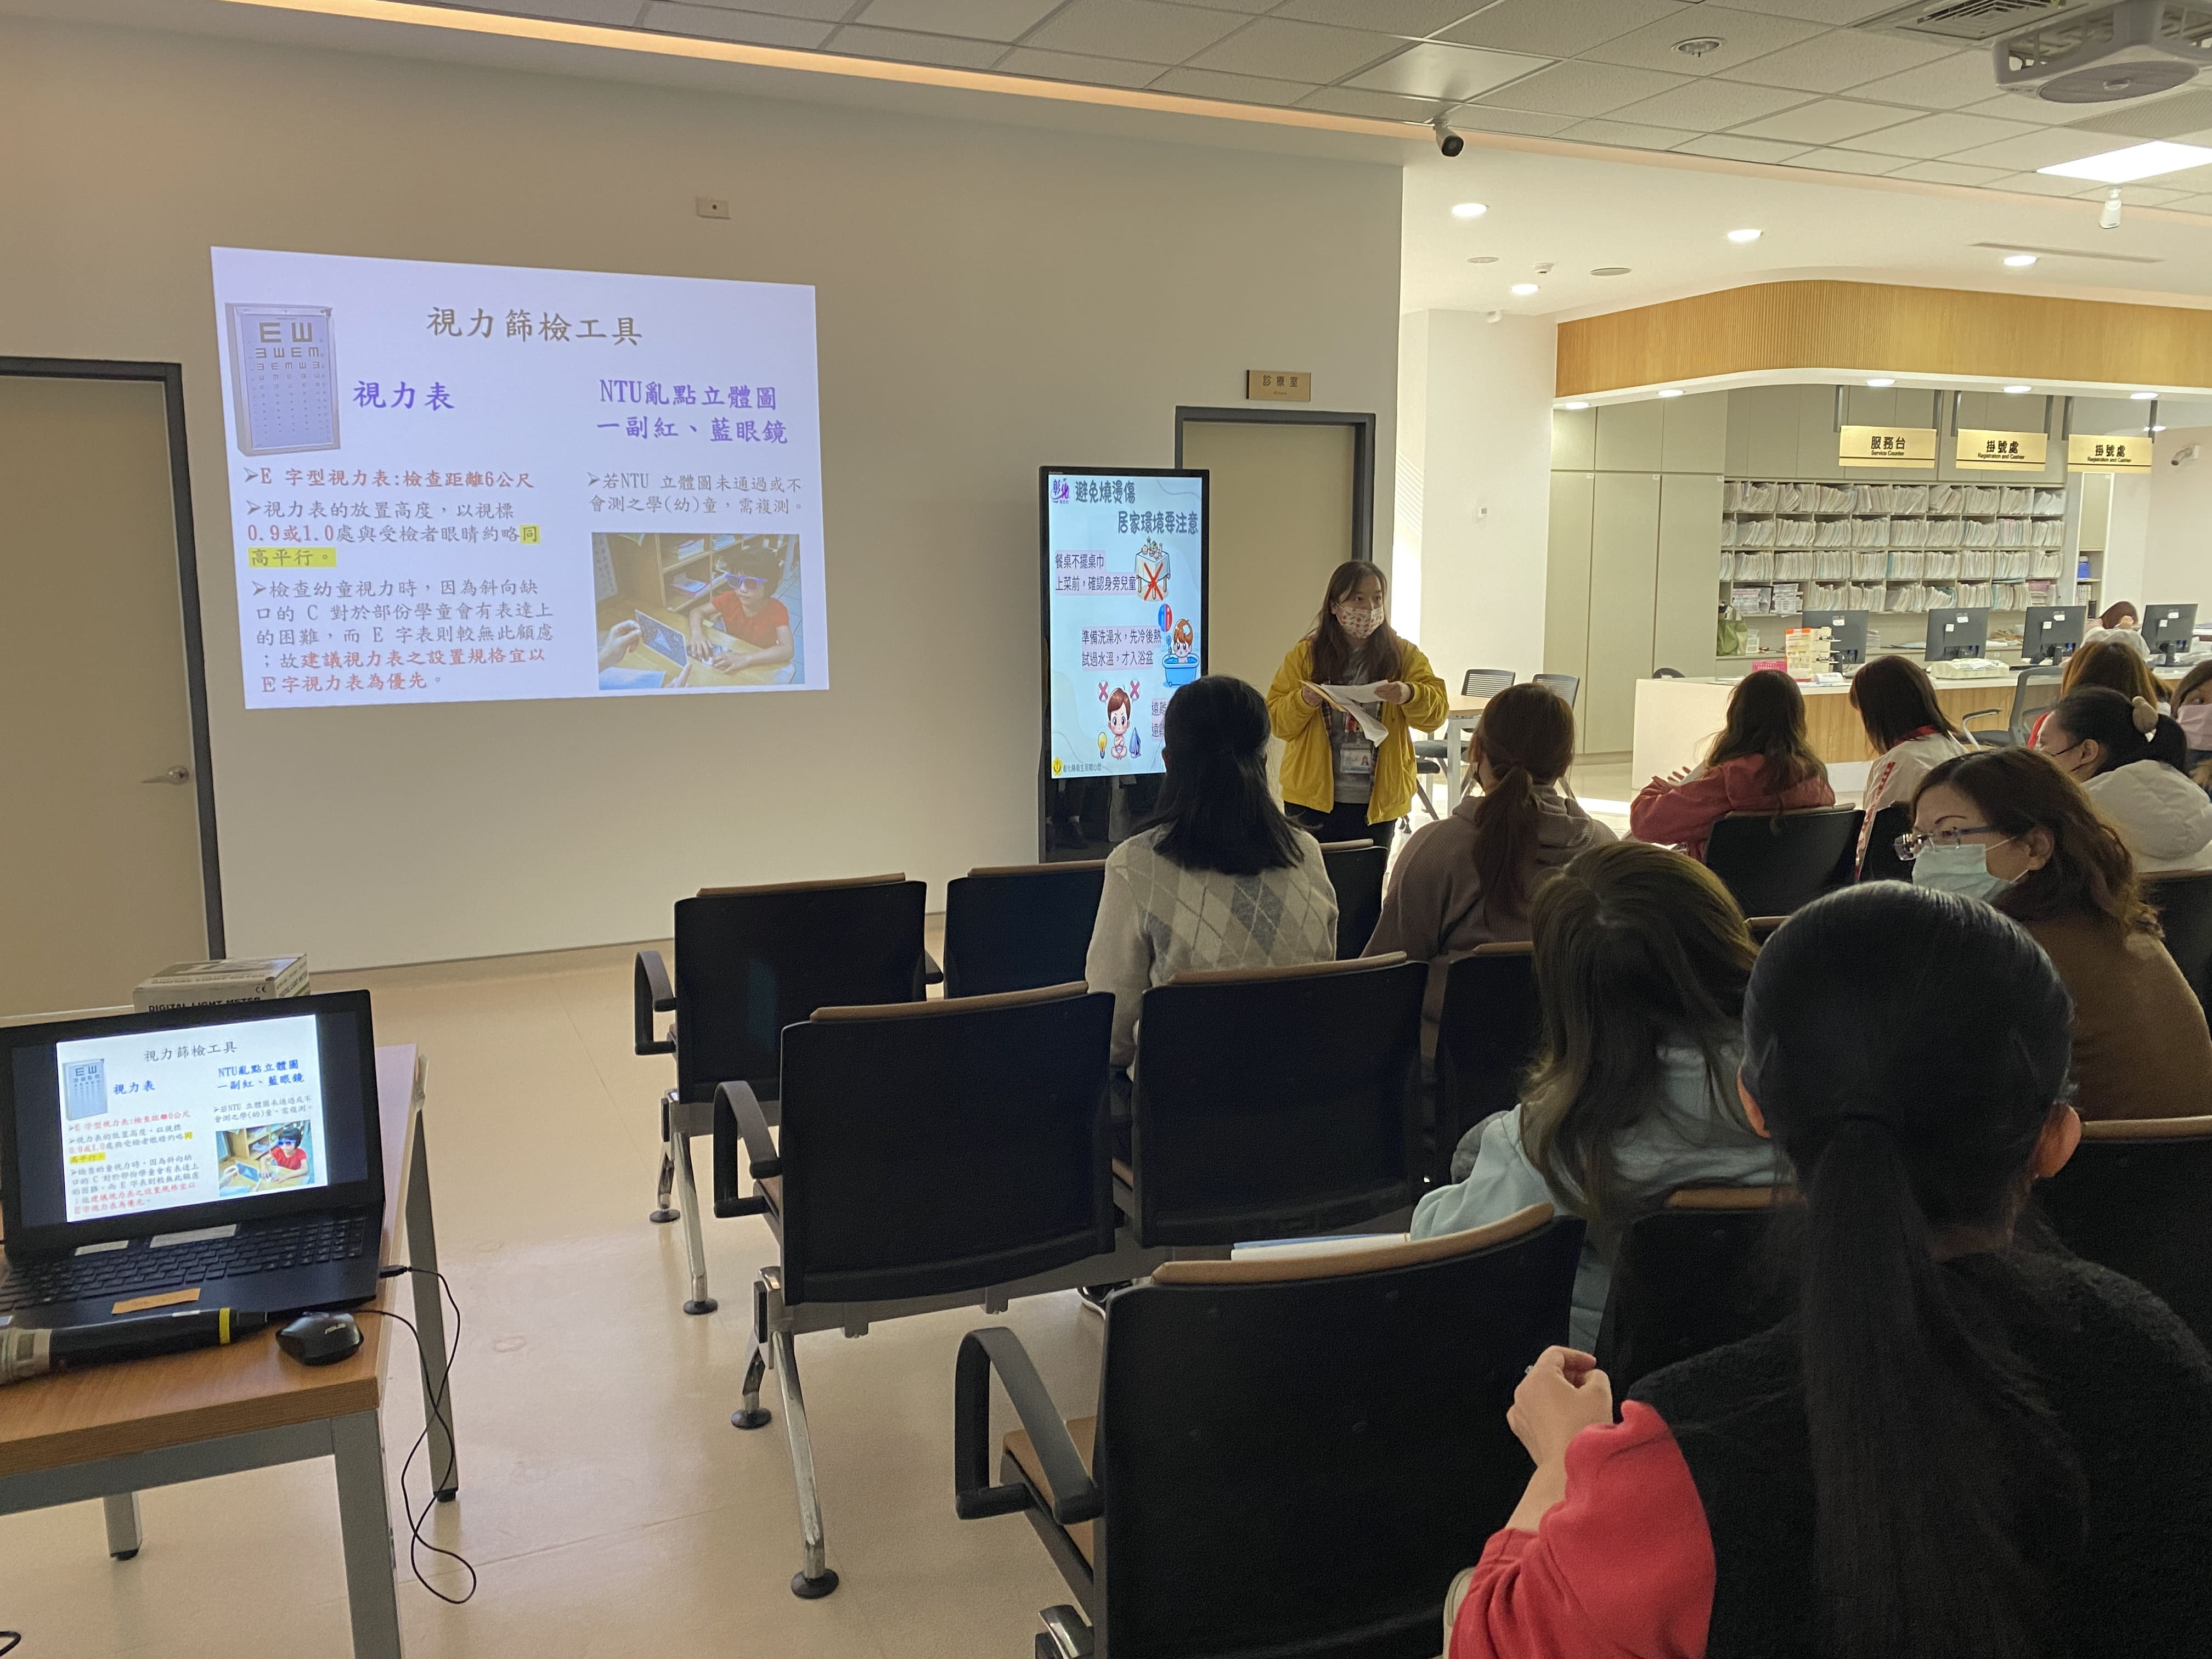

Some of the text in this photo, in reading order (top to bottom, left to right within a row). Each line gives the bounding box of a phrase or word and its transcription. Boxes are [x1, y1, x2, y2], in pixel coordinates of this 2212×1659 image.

[426, 307, 642, 346] 視力篩檢工具
[352, 380, 454, 410] 視力表
[600, 379, 776, 410] NTU亂點立體圖
[596, 416, 788, 444] 一副紅、藍眼鏡
[1871, 436, 1905, 449] 服務台
[1986, 440, 2019, 453] 掛號處
[2095, 445, 2125, 457] 掛號處
[260, 467, 272, 484] E
[1075, 479, 1135, 504] 避免燒燙傷
[1118, 510, 1198, 535] 居家環境要注意
[1055, 554, 1104, 569] 餐桌不擺桌巾
[307, 605, 318, 620] C
[373, 627, 383, 642] E
[144, 1041, 237, 1062] 視力篩檢工具
[113, 1080, 155, 1094] 視力表
